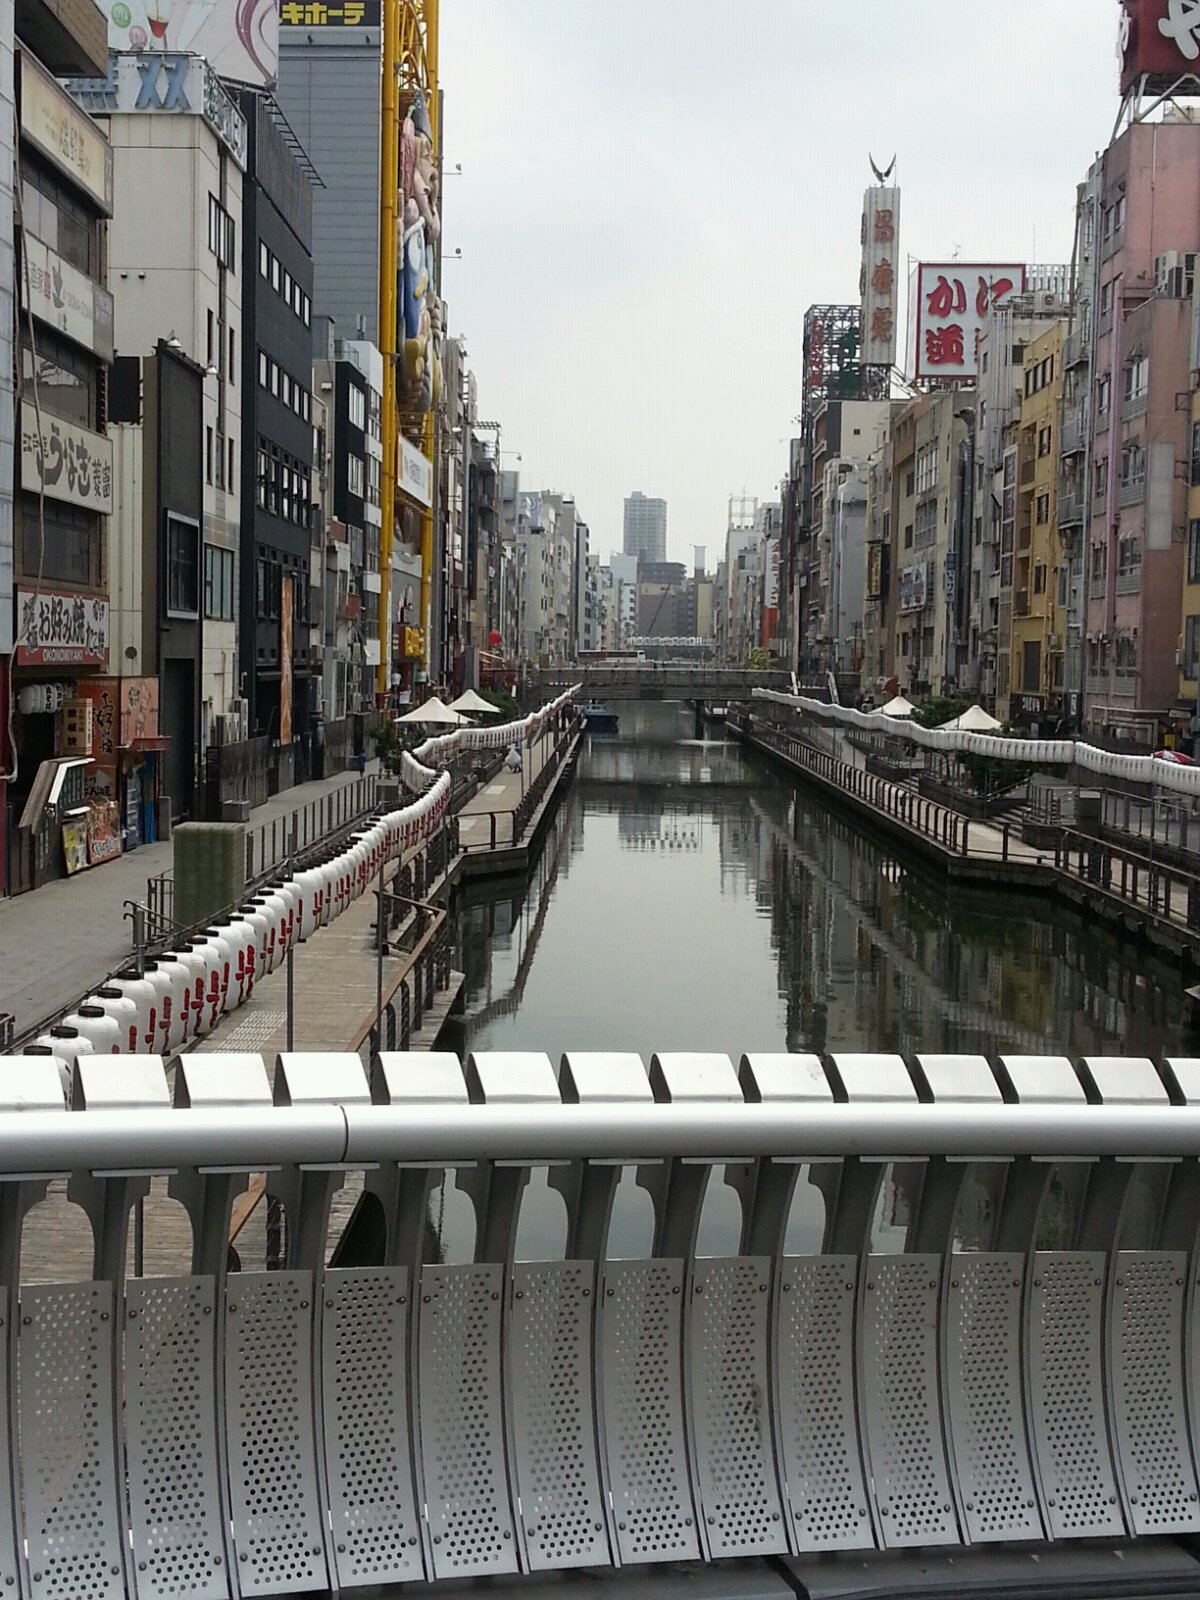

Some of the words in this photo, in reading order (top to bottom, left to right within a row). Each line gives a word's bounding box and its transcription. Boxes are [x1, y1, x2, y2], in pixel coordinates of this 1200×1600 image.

[279, 2, 365, 25] キホーテ
[926, 323, 980, 366] 道
